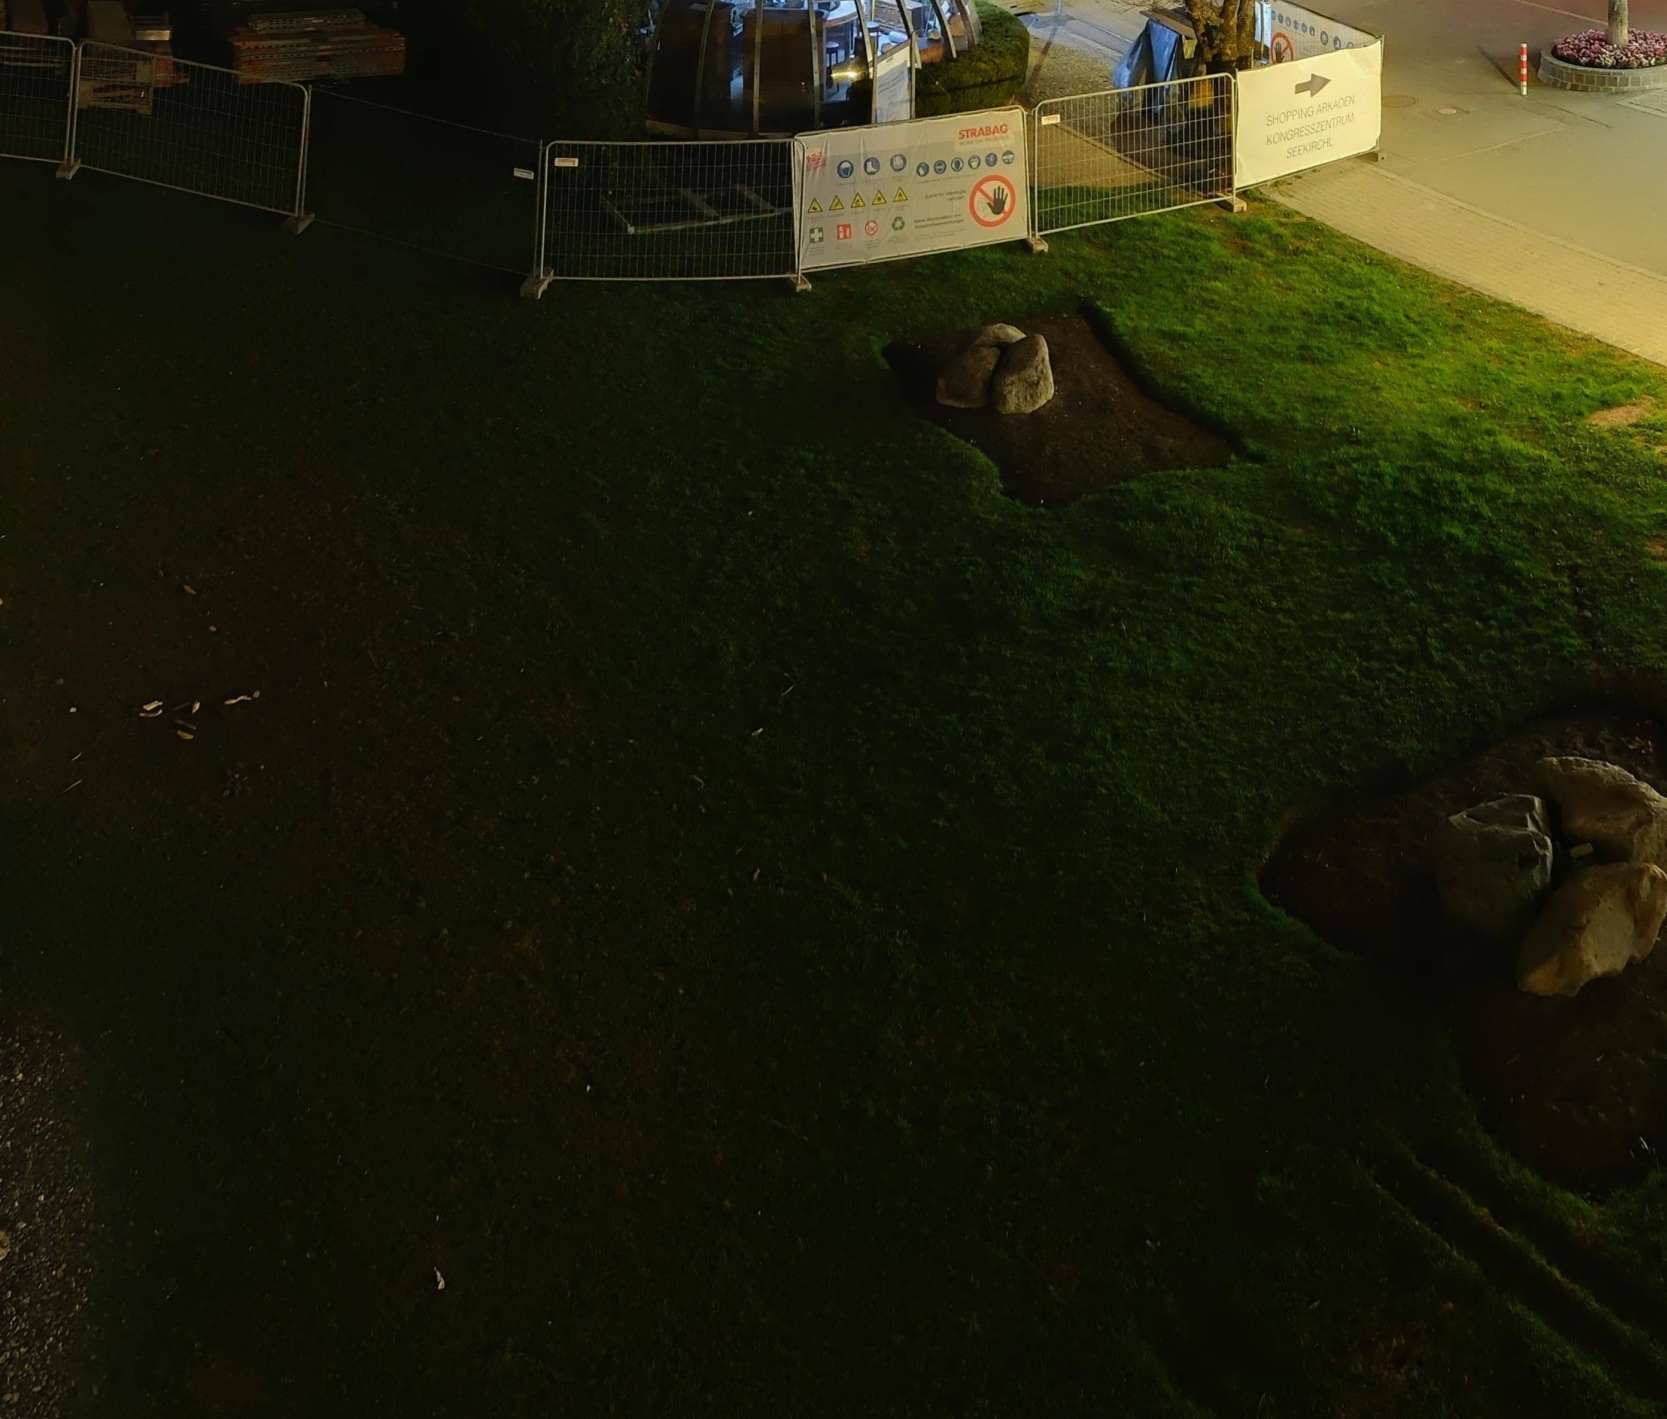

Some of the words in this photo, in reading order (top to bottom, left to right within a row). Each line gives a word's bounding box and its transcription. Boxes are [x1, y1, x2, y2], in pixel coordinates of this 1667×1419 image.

[1266, 106, 1314, 126] SHOPPING
[1315, 95, 1356, 115] ARKADEN
[959, 124, 1008, 140] STRABAG
[1266, 113, 1355, 145] KONGRESSZENTRUM
[1286, 137, 1334, 159] SEEKIRCHL
